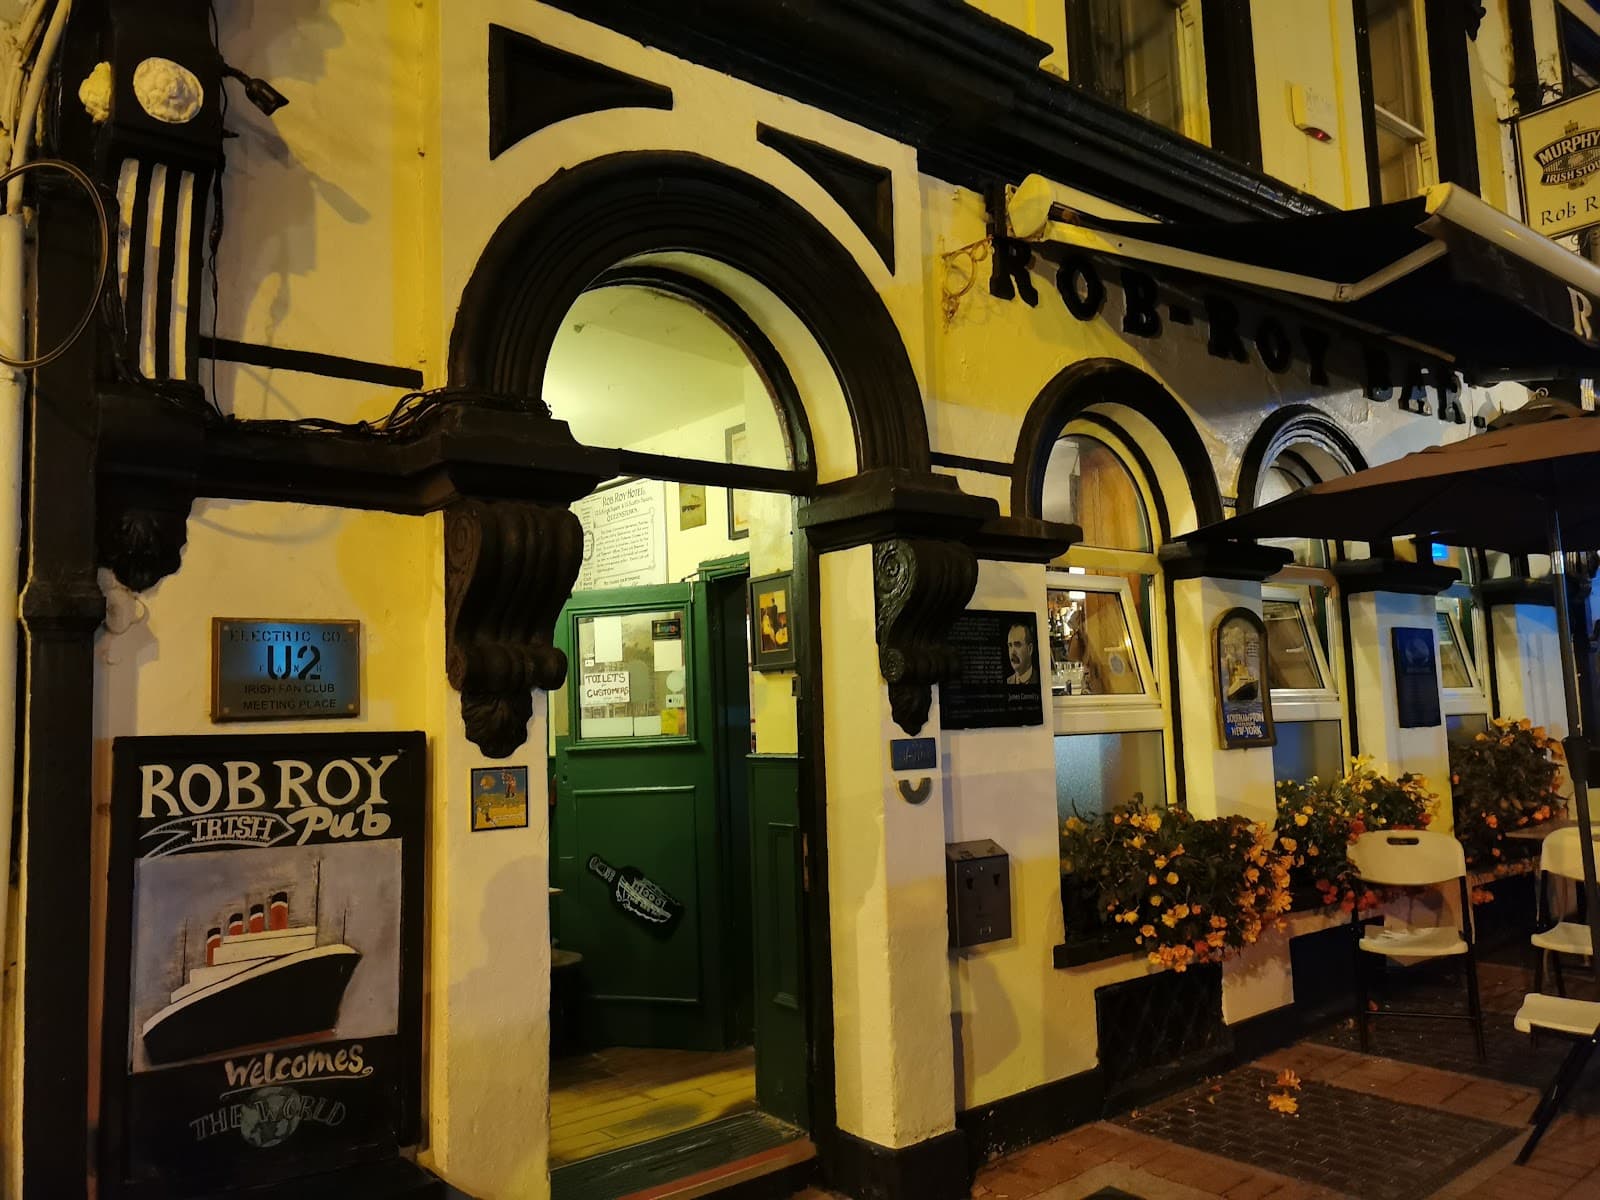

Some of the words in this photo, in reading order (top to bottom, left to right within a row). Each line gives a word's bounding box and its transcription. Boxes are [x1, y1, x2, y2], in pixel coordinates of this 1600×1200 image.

[1545, 170, 1575, 184] IRISH
[1541, 201, 1577, 226] Rob
[229, 630, 312, 642] ELECTRIC
[266, 644, 321, 681] U2
[585, 672, 626, 684] TOILETS
[243, 683, 275, 695] IRISH
[279, 683, 301, 694] FAN
[304, 682, 335, 694] CLUB
[242, 700, 296, 712] MEETING
[299, 698, 337, 710] PLACE
[138, 761, 266, 818] ROB
[272, 754, 399, 809] ROY
[191, 816, 277, 843] IRISH
[286, 803, 392, 846] Pub
[188, 1102, 244, 1141] THE
[255, 1094, 347, 1127] WORLD
